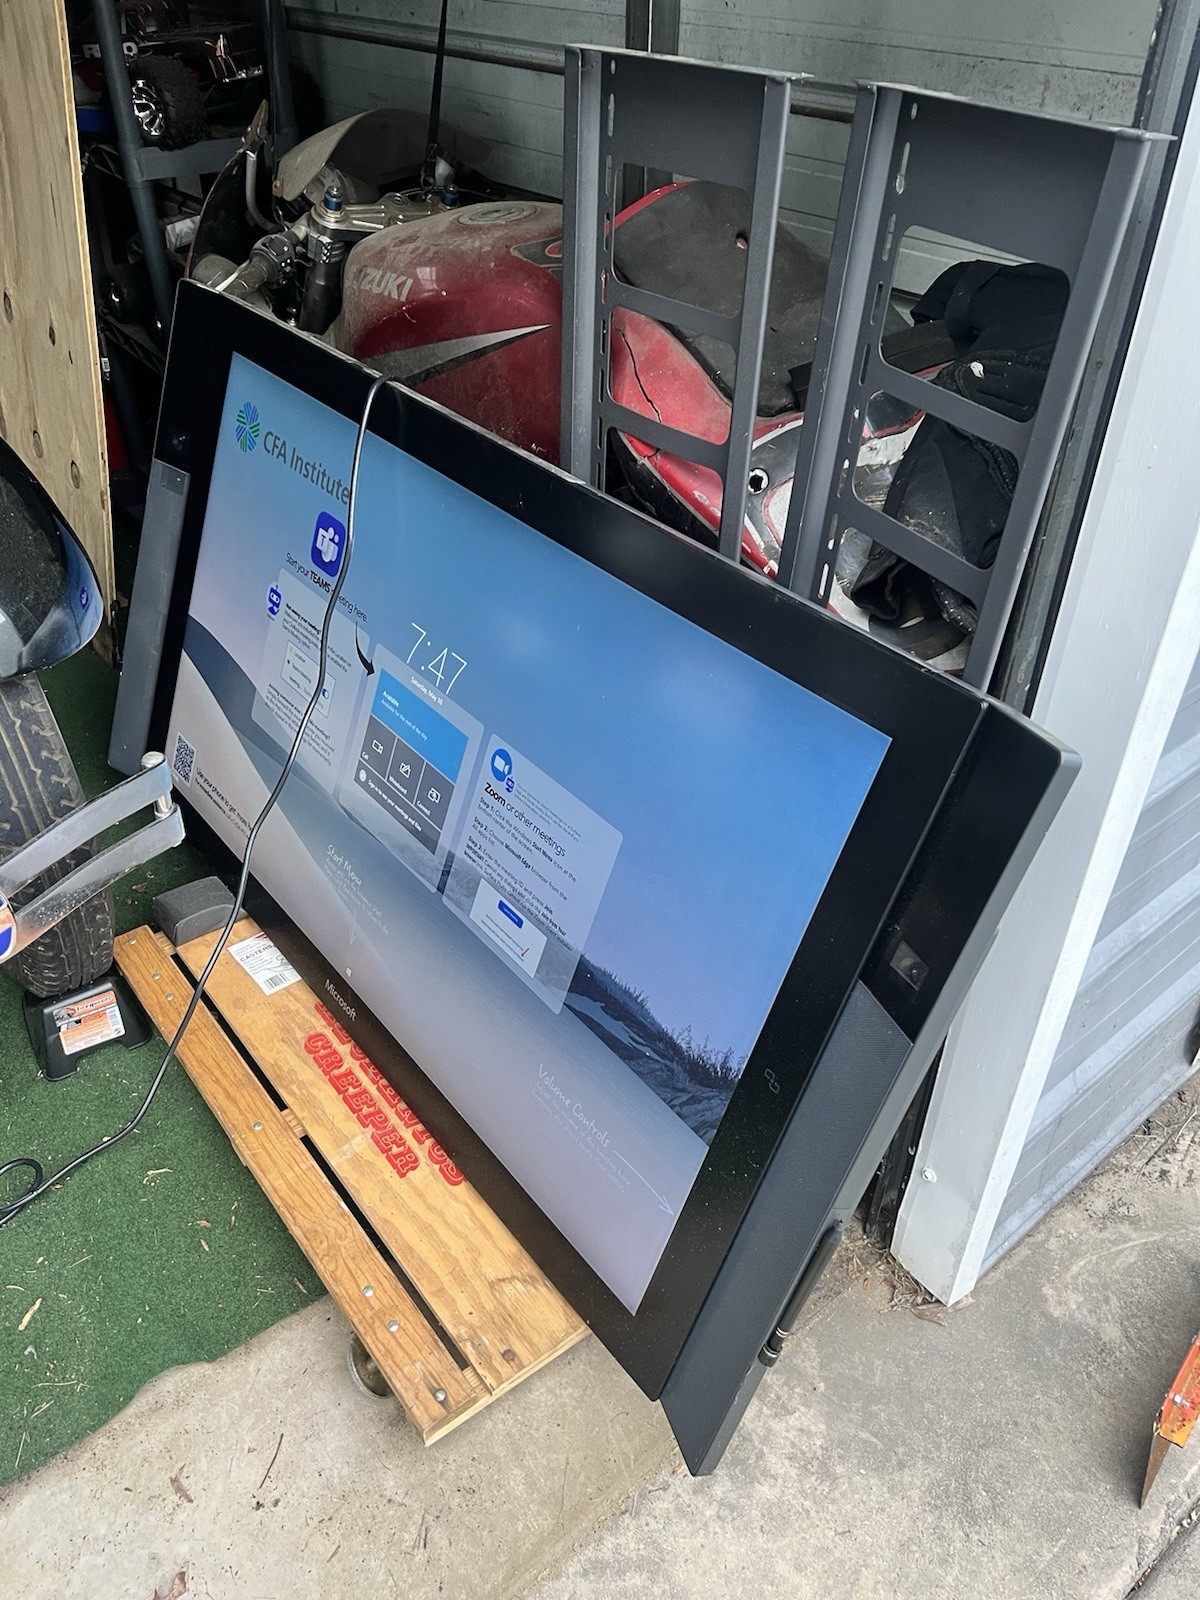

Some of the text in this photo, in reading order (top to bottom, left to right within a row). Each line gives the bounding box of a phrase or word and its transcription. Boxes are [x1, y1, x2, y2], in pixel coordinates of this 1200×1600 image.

[356, 265, 414, 302] ZUKI
[263, 430, 350, 506] CFA Institute
[285, 551, 298, 569] Start
[296, 562, 309, 580] your
[309, 570, 330, 593] TEAMS
[406, 622, 467, 695] 7:47
[326, 844, 344, 866] Start
[484, 781, 506, 807] Zoom
[505, 802, 514, 814] or
[513, 805, 533, 830] other
[531, 822, 567, 860] meetings
[325, 978, 357, 1022] Microsoft
[304, 1031, 420, 1178] CREEPER
[538, 1062, 611, 1148] Volume Controls
